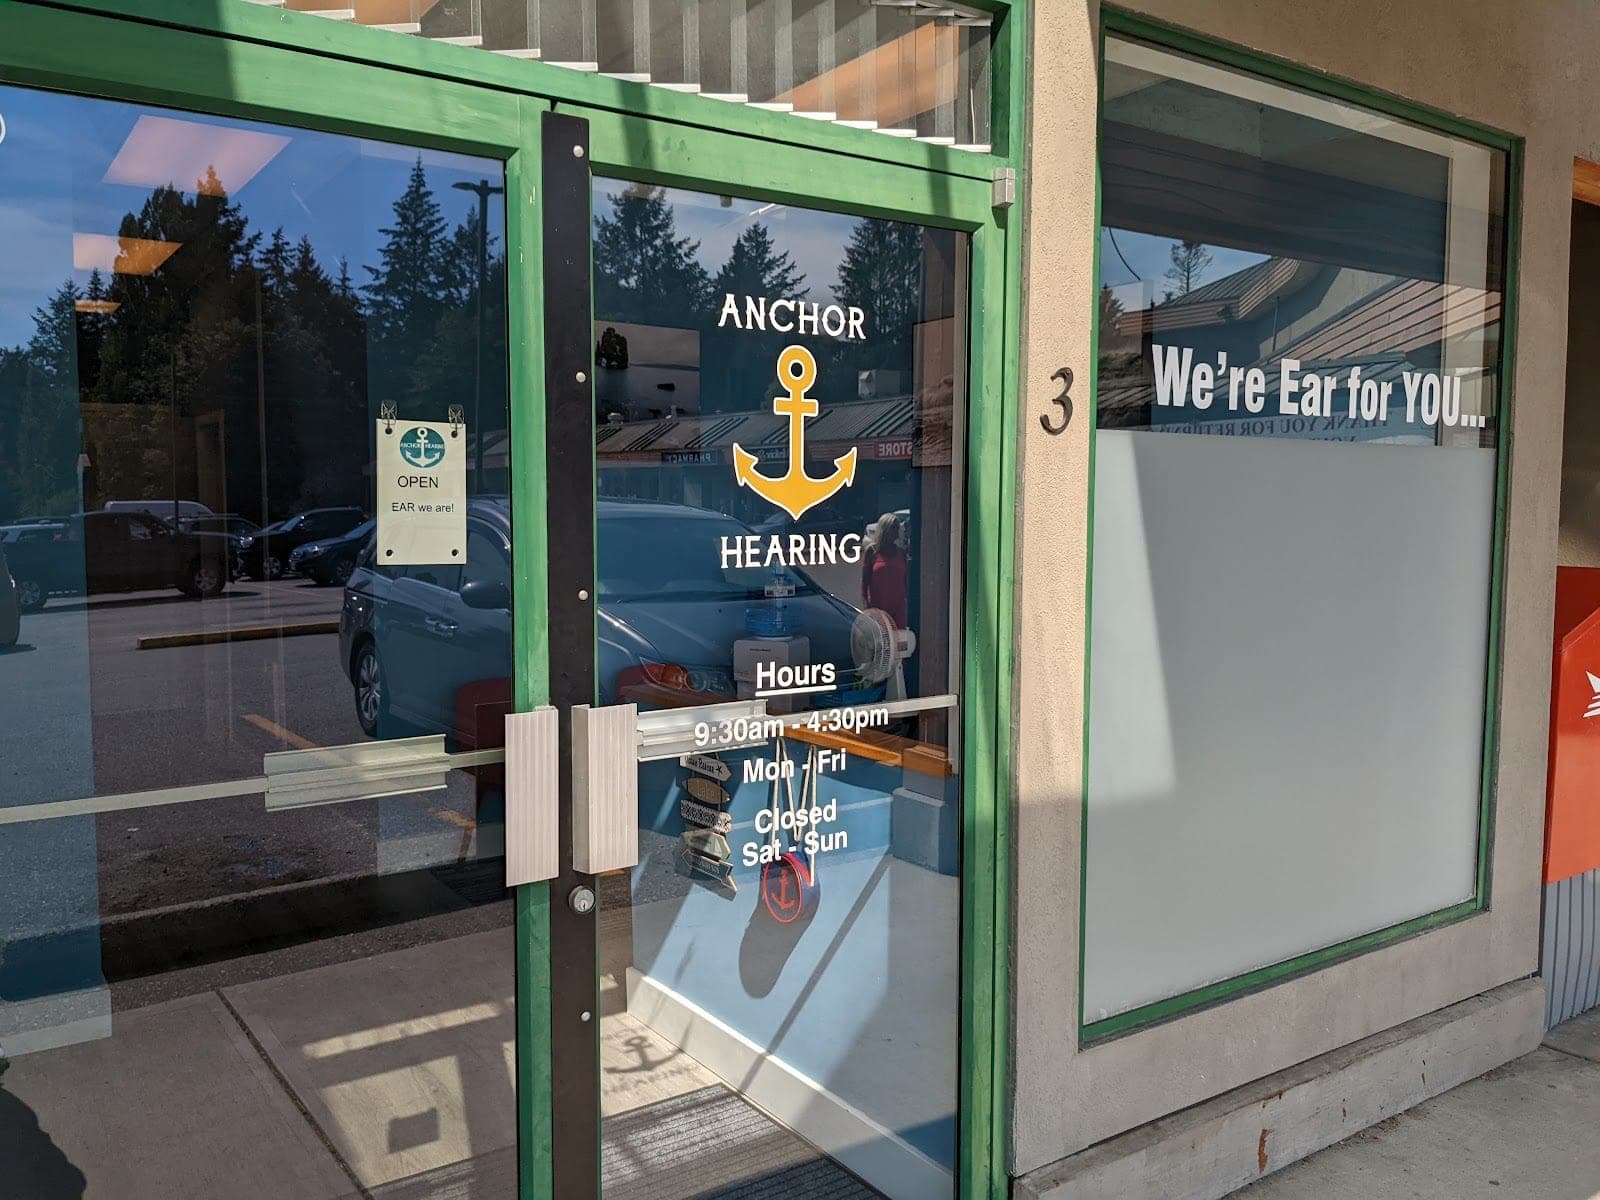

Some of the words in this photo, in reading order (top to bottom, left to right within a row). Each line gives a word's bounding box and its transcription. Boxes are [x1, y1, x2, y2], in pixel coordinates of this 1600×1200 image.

[718, 293, 866, 339] ANCHOR
[1040, 367, 1074, 436] 3
[1152, 344, 1266, 414] We're
[1279, 358, 1336, 418] Ear
[1348, 366, 1392, 421] for
[1402, 371, 1486, 428] YOU...
[397, 475, 439, 489] OPEN
[391, 502, 415, 512] EAR
[435, 503, 454, 513] are!
[720, 533, 861, 569] HEARING
[756, 661, 836, 690] Hours
[694, 717, 785, 746] 9:30am
[791, 722, 801, 730] -
[807, 707, 889, 735] 4:30pm
[743, 757, 795, 784] Mon
[818, 748, 846, 774] Fri
[755, 799, 837, 834] Closed
[742, 839, 782, 867] Sat
[804, 830, 848, 855] Sun
